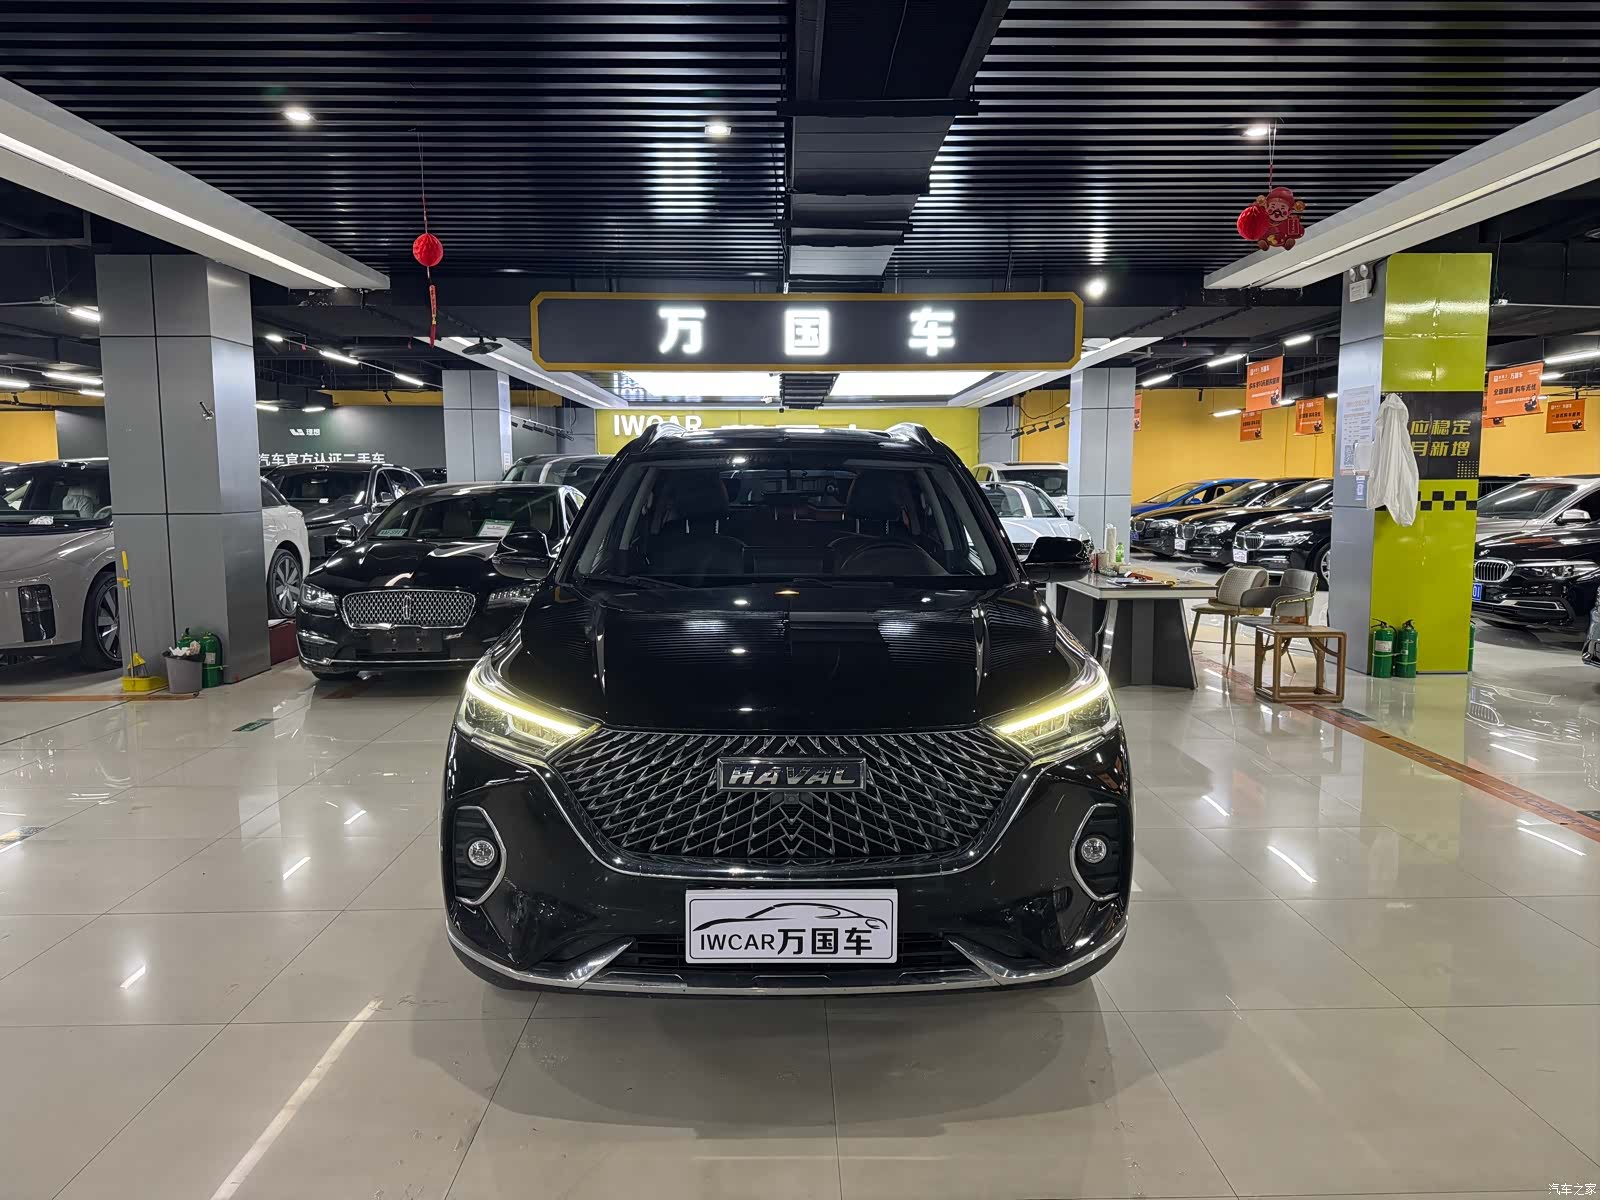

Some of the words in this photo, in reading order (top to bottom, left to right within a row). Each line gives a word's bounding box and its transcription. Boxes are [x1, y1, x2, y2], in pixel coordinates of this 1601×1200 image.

[658, 307, 956, 356] 万国车
[1410, 419, 1472, 436] 应稳定
[728, 766, 856, 785] HAVAL
